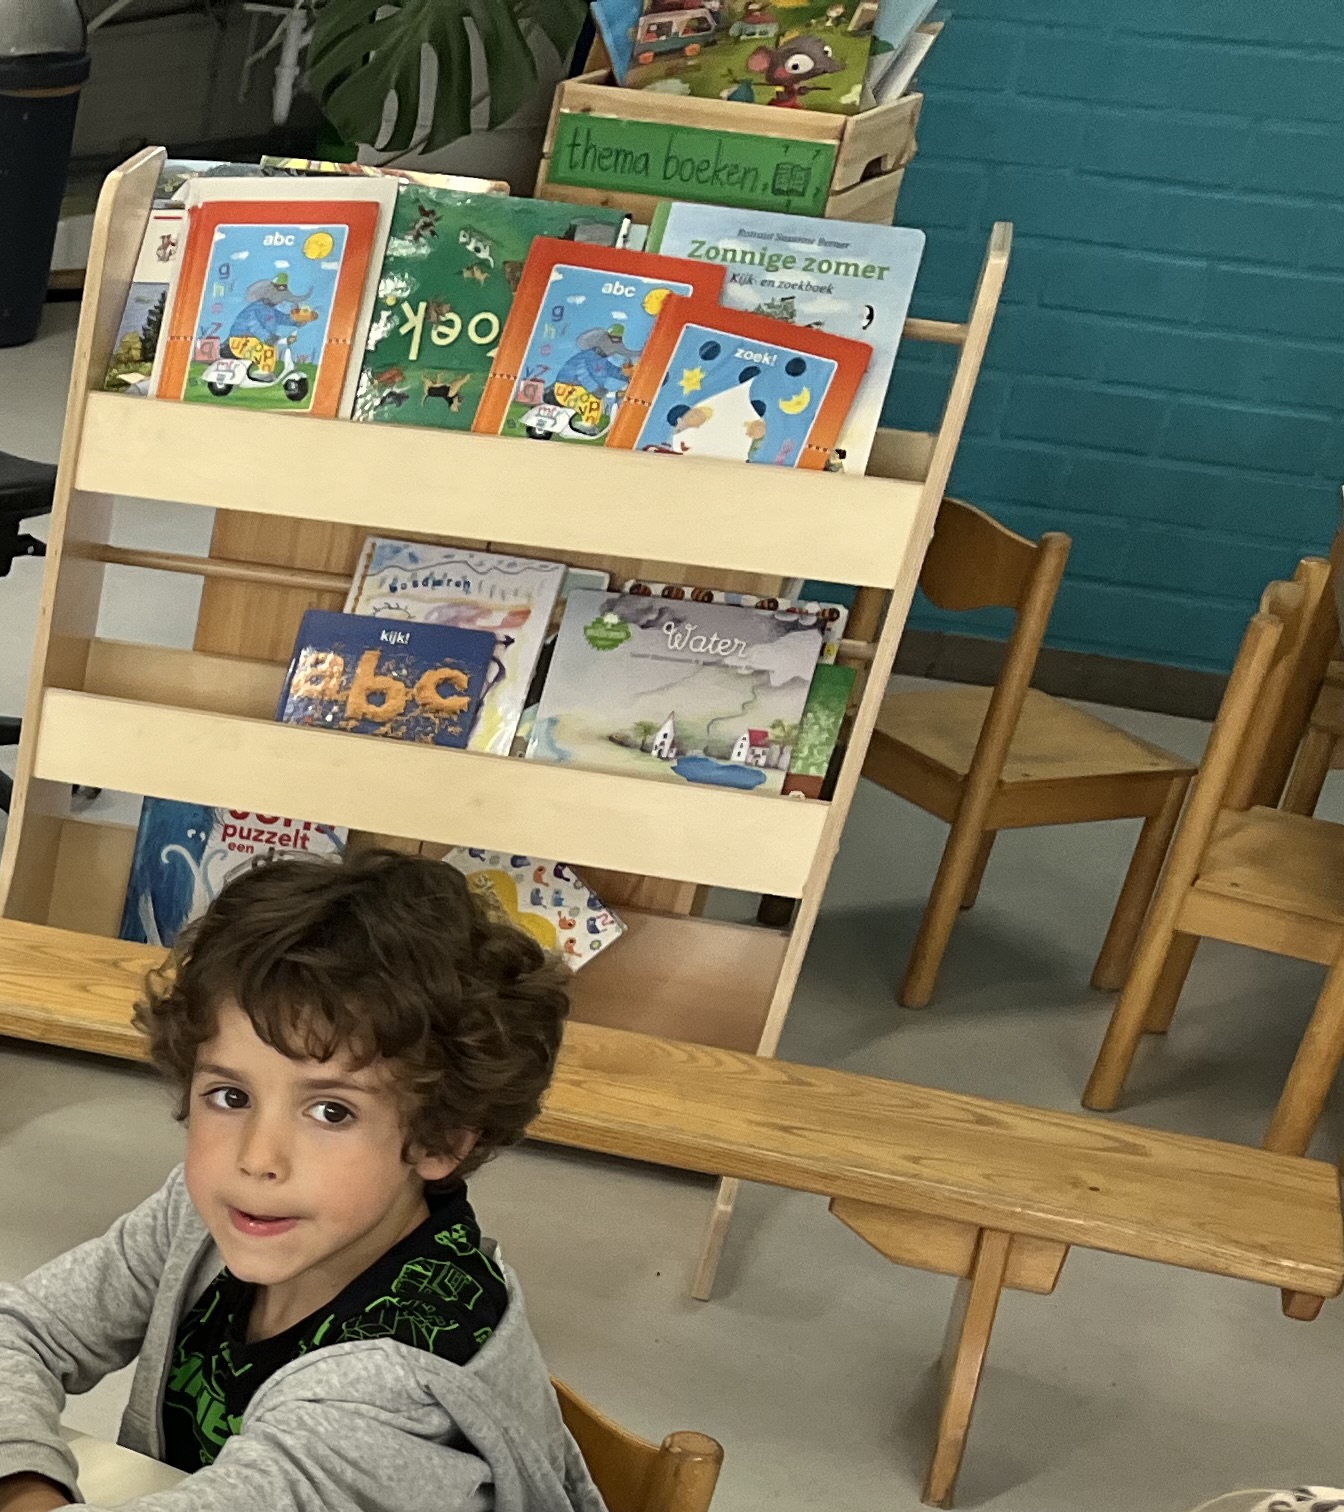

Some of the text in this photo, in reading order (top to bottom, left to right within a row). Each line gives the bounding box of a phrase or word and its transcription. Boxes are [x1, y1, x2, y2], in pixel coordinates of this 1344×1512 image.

[567, 127, 759, 193] thema boeken
[263, 231, 296, 247] abc
[687, 239, 891, 281] Zonnige zomer
[601, 281, 636, 298] abc
[760, 278, 775, 288] en
[776, 278, 835, 295] zoekboek
[398, 301, 502, 360] oek
[734, 347, 779, 366] zoek!
[380, 630, 410, 645] kijk!
[663, 621, 747, 658] Water
[290, 648, 470, 722] abc
[221, 823, 310, 850] puzzelt
[228, 842, 255, 854] een
